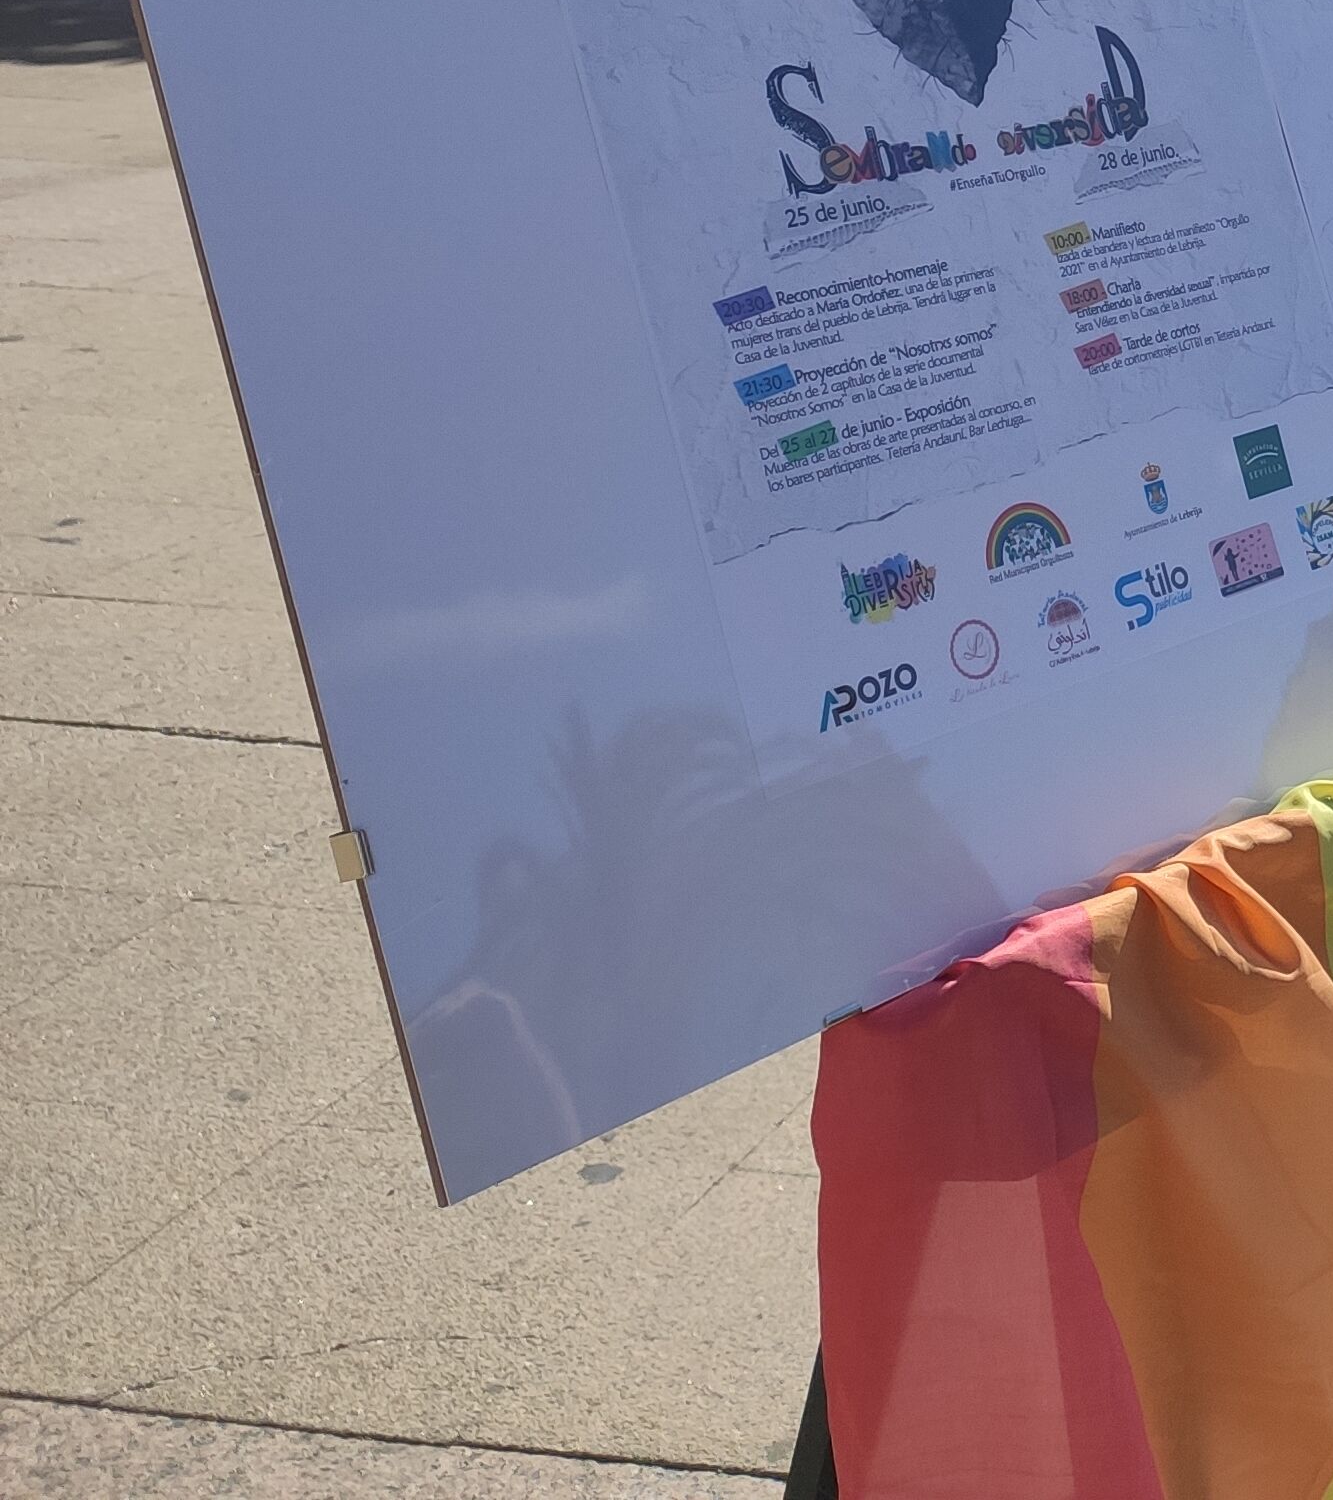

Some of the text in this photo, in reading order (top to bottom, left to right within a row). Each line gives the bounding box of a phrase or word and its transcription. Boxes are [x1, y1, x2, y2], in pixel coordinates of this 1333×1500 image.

[1097, 141, 1180, 171] 28 de junio.
[949, 165, 1047, 192] #EnseñaTuOrgullo
[784, 194, 891, 228] 25 de junio.
[1050, 220, 1146, 250] 10:00 Manifiesto
[1081, 221, 1216, 258] de bandera lectura del manifiesto
[1109, 247, 1166, 268] Ayuntamiento
[1166, 242, 1178, 253] de
[721, 258, 949, 318] 20:30 Reconocimiento-homenaje
[755, 306, 806, 328] dedicado
[816, 297, 850, 315] María
[905, 282, 924, 296] una
[925, 277, 940, 291] de
[940, 274, 954, 288] las
[954, 267, 995, 288] primeras
[1065, 277, 1142, 306] 18:00 Charla
[1143, 284, 1187, 303] diversidad
[1257, 264, 1271, 278] por
[731, 331, 774, 350] mujeres
[776, 323, 802, 340] trans
[803, 318, 822, 333] del
[822, 311, 860, 333] pueblo
[861, 306, 876, 320] de
[913, 290, 947, 309] Tendrá
[947, 286, 972, 303] lugar
[973, 284, 987, 296] en
[1074, 320, 1094, 335] Sara
[1140, 304, 1160, 318] Casa
[734, 330, 844, 366] Casa de la Juventud.
[1082, 321, 1202, 362] 20:00 Tarde de cortos
[1123, 344, 1178, 367] cortometrajes
[742, 376, 784, 397] 21:30
[794, 355, 868, 385] Proyección
[868, 349, 888, 365] de
[804, 384, 820, 399] de
[830, 370, 877, 393] capítulos
[877, 366, 892, 381] de
[903, 358, 927, 375] serie
[927, 345, 985, 370] documental
[851, 391, 866, 405] en
[877, 380, 903, 397] Casa
[903, 376, 918, 391] de
[929, 362, 976, 385] Juventud.
[759, 394, 972, 461] Del 25 al 27 de junio Exposición
[763, 394, 1037, 477] Muestra de las obras de arte presentadas al en
[767, 478, 786, 493] los
[786, 470, 816, 489] bares
[886, 441, 922, 460] Tetería
[968, 422, 986, 439] Bar
[1114, 561, 1189, 631] Stilo
